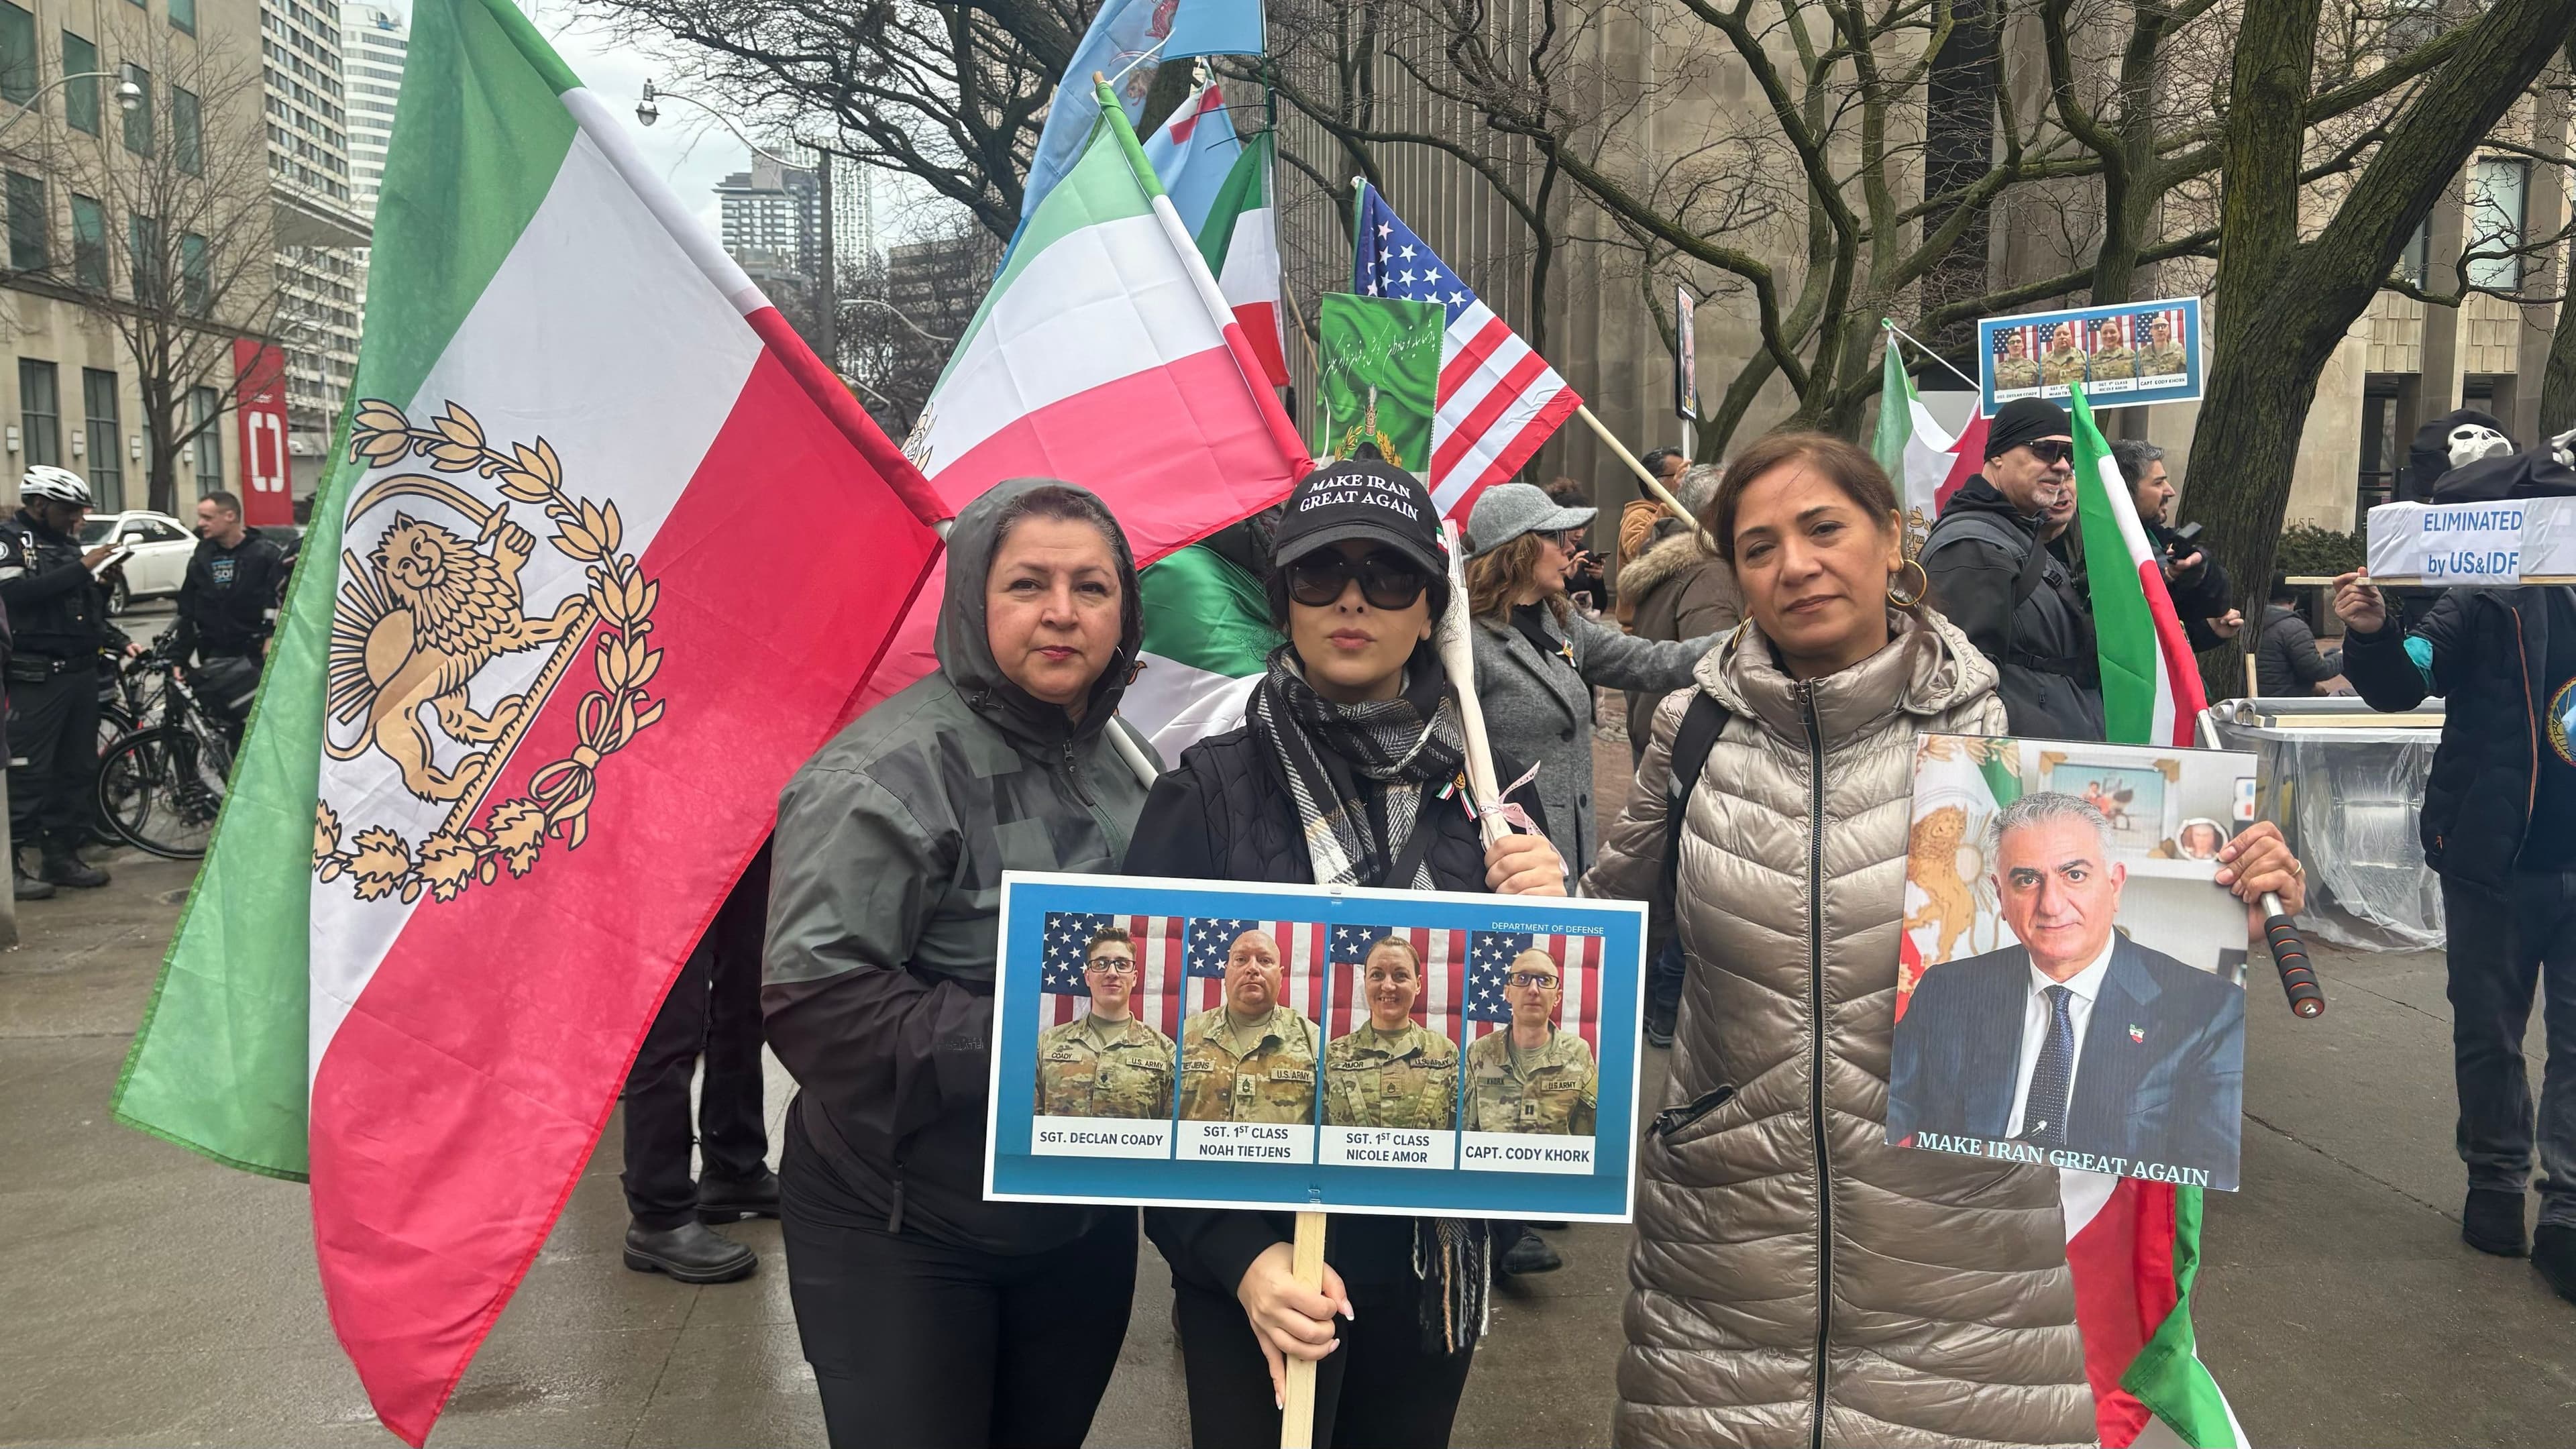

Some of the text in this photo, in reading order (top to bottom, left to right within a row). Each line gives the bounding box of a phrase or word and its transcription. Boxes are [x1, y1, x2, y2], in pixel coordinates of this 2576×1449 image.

[1309, 474, 1411, 499] MAKE IRAN
[1299, 490, 1419, 521] GREAT AGAIN
[2424, 511, 2522, 532] ELIMINATED
[2428, 552, 2519, 577] by US&IDF
[1491, 922, 1549, 932] DEPARTMENT
[1566, 926, 1604, 934] DEFENSE
[1144, 1060, 1164, 1069] ARMY
[1277, 1071, 1309, 1080] U.S. ARMY
[1040, 1132, 1164, 1146] SGT. DECLAN COADY
[1203, 1125, 1289, 1140] SGT. 1ST CLASS
[1346, 1132, 1430, 1146] SGT. 1ST CLASS
[1199, 1144, 1291, 1158] NOAH TIETJENS
[1346, 1150, 1428, 1163] NICOLE AMOR
[1466, 1146, 1590, 1163] CAPT. CODY KHORK
[1917, 1131, 2209, 1187] MAKE IRAN GREAT AGAIN
